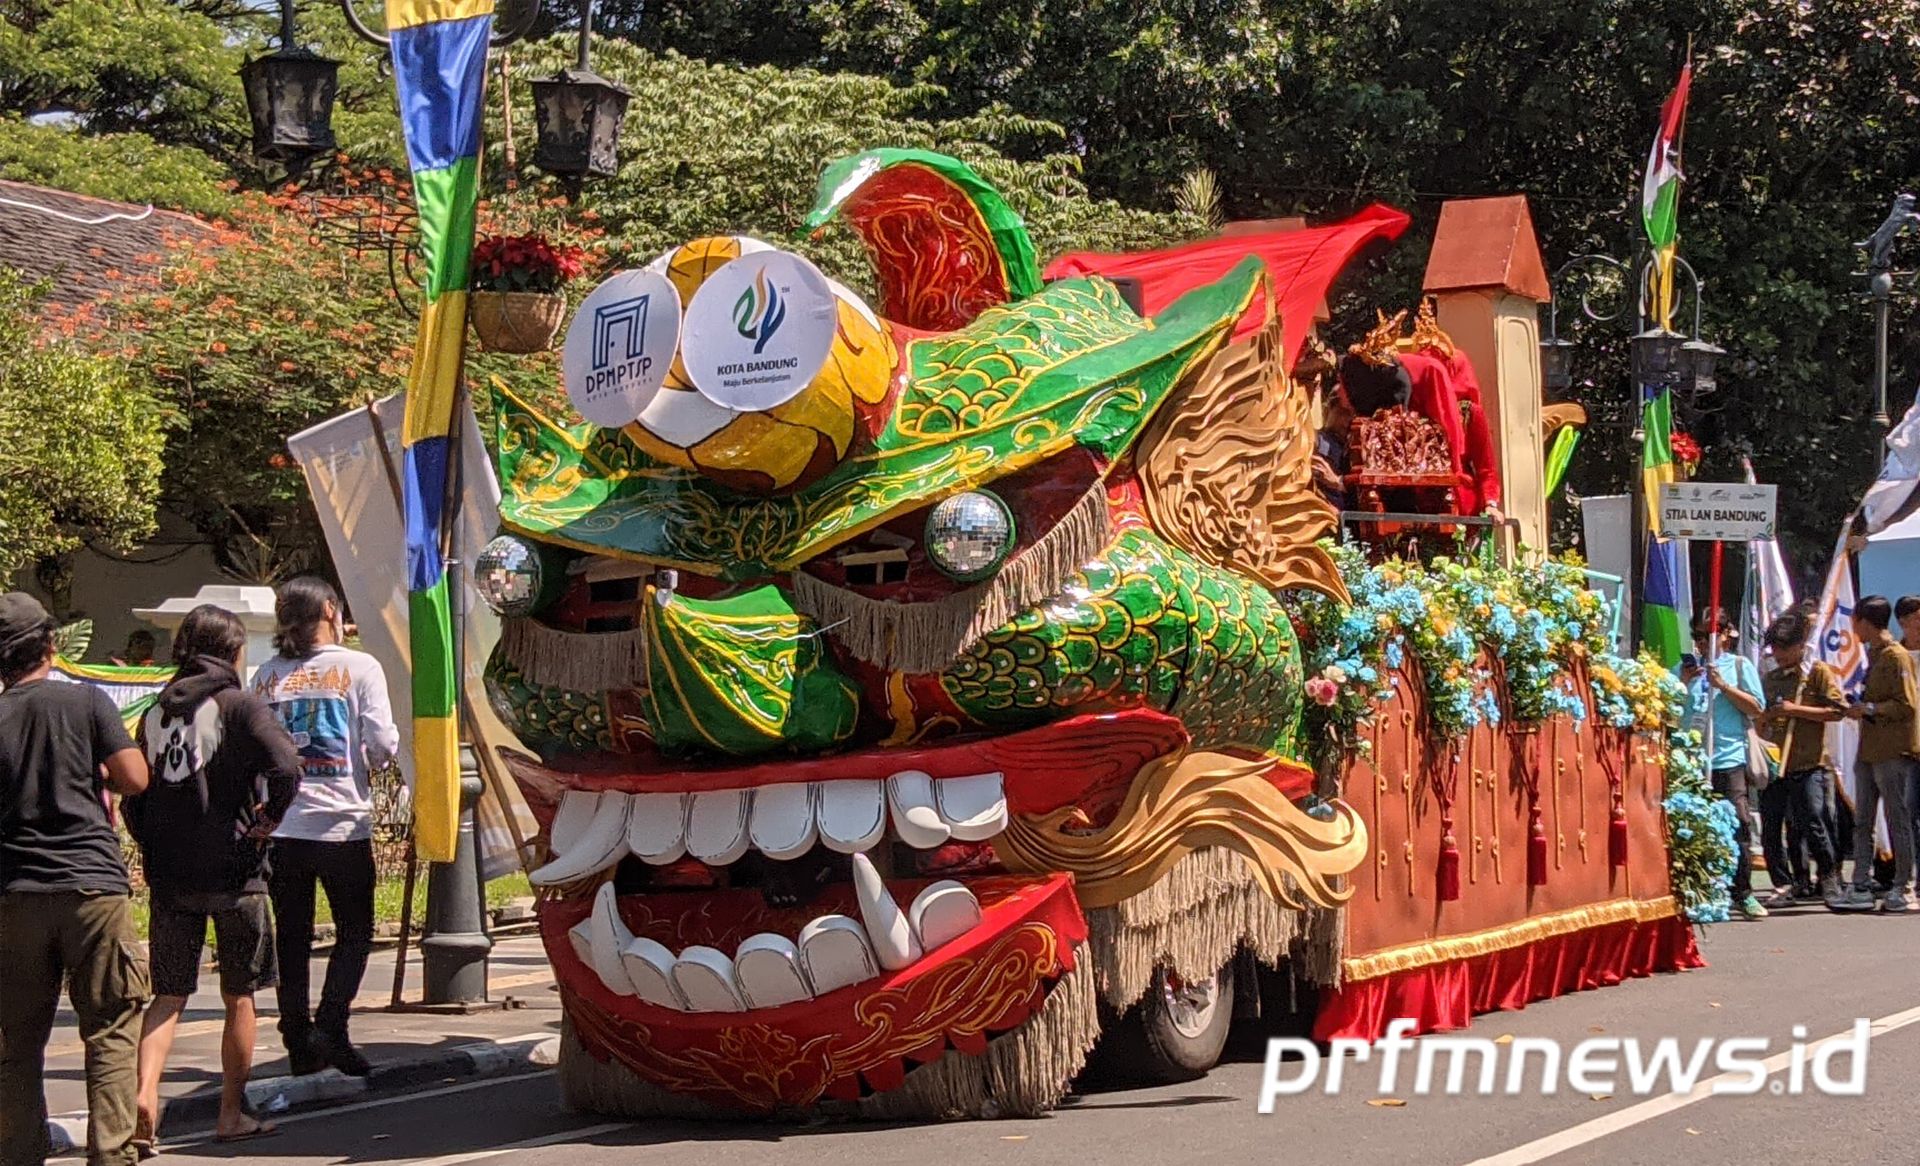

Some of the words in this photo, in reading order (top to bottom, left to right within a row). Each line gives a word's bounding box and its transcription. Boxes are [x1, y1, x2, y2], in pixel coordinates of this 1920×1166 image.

[717, 364, 745, 376] KOTA
[746, 357, 798, 373] BANDUNG
[586, 357, 652, 394] DPMPTSP
[723, 377, 741, 389] Maju
[1665, 508, 1687, 520] STIA
[1690, 509, 1711, 521] LAN
[1714, 510, 1767, 522] BANDUNG
